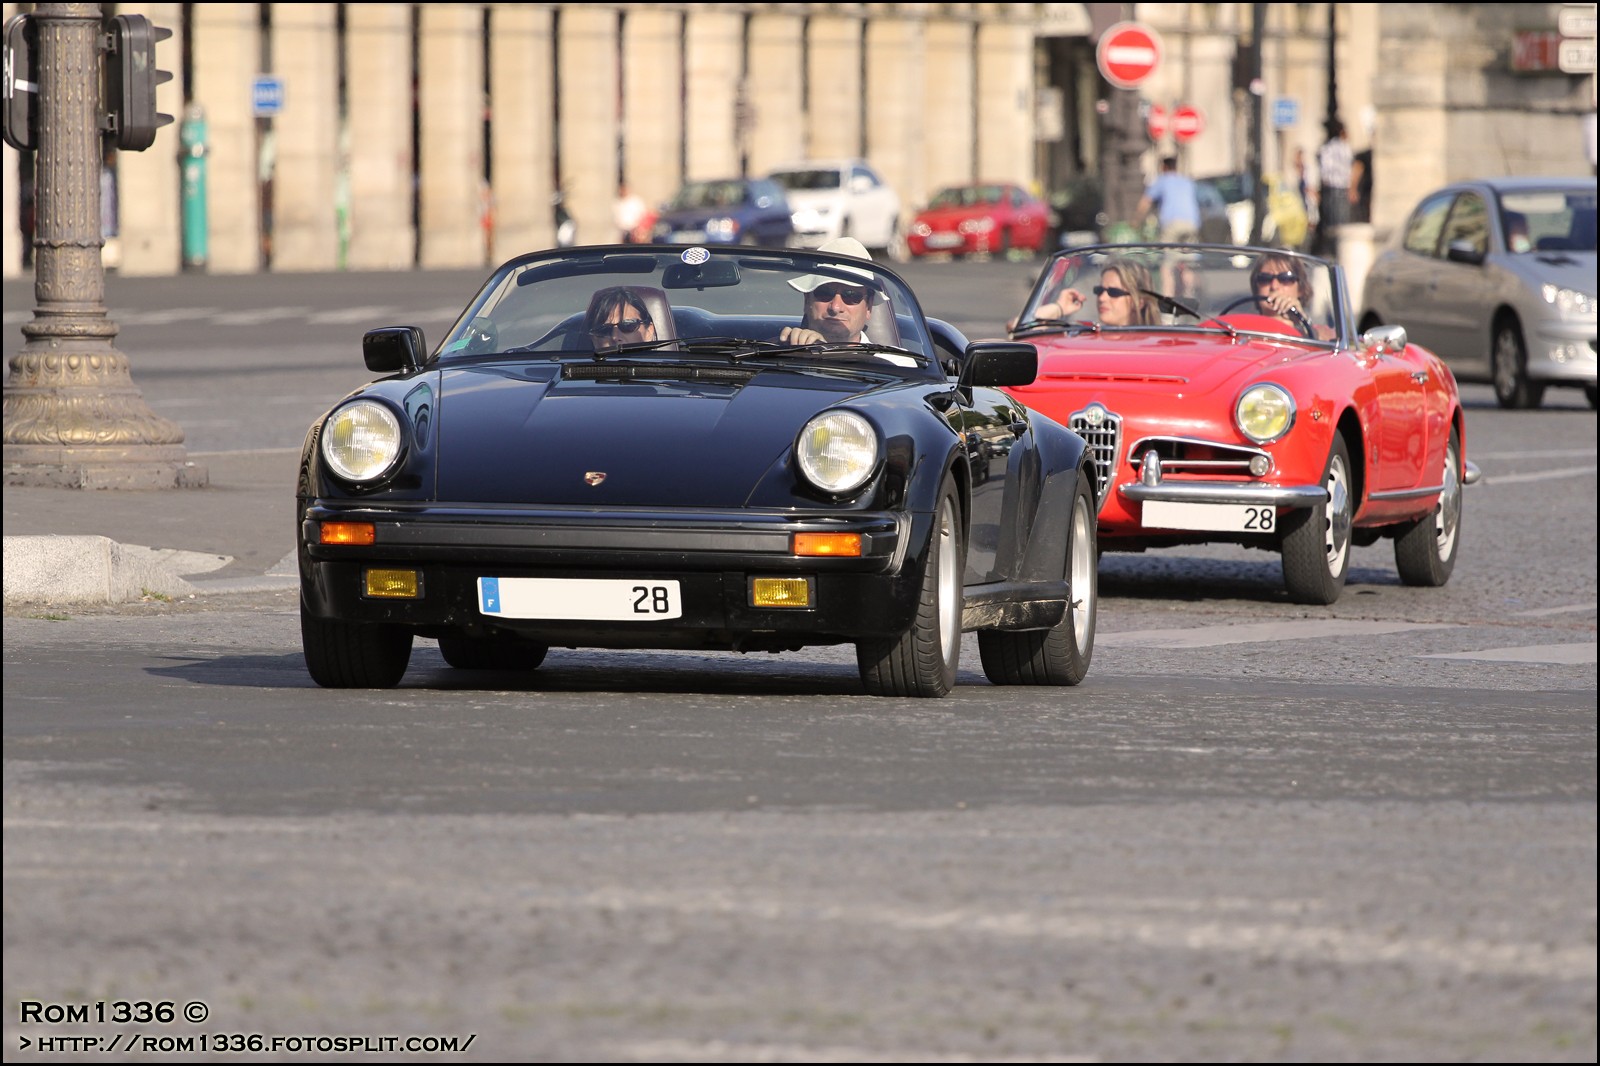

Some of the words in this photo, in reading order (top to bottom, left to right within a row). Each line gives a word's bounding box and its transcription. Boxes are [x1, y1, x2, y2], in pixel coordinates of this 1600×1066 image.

[1243, 507, 1273, 530] 28
[487, 598, 495, 608] F
[632, 586, 669, 614] 28
